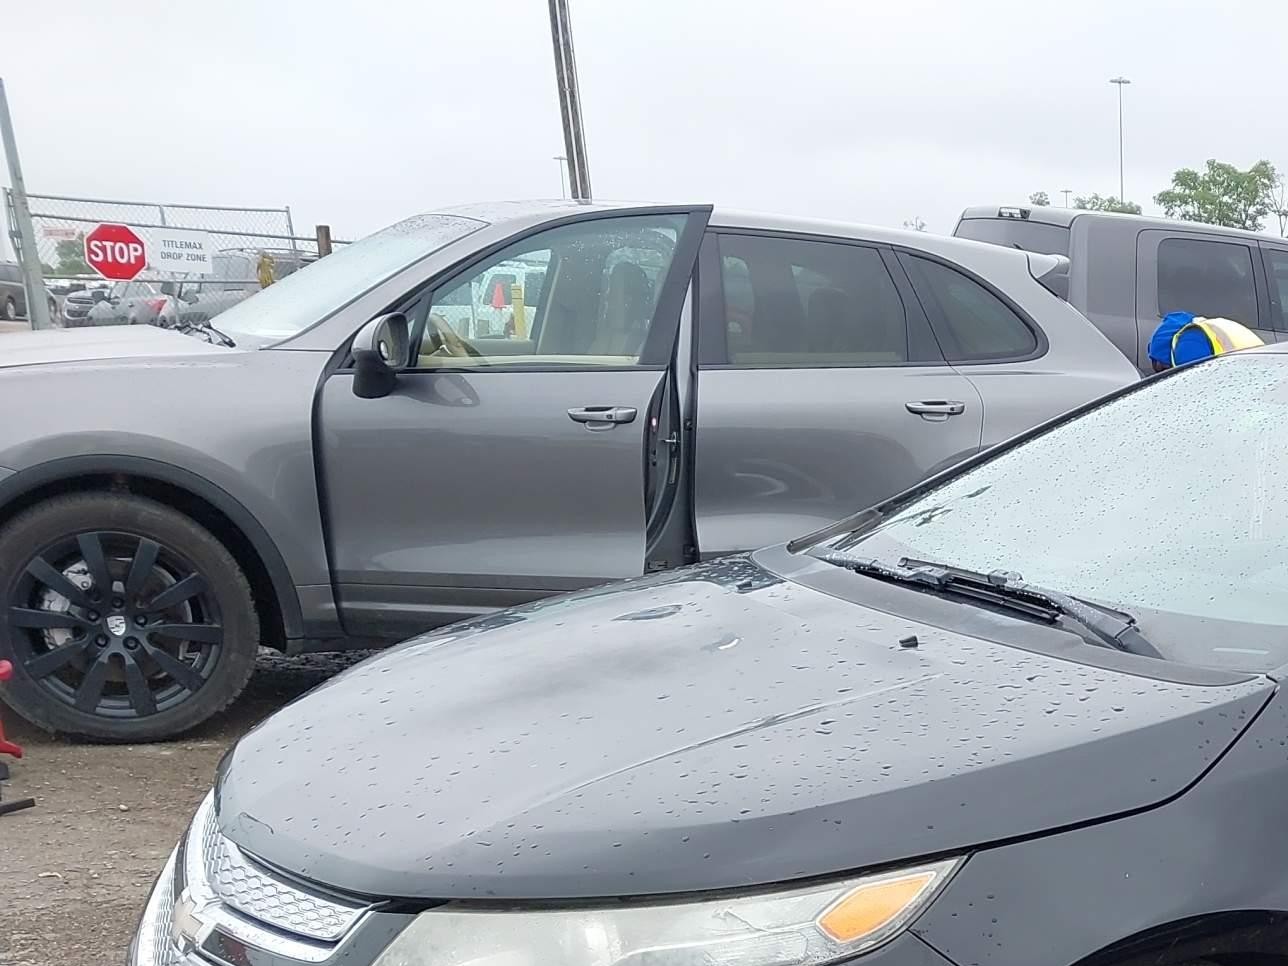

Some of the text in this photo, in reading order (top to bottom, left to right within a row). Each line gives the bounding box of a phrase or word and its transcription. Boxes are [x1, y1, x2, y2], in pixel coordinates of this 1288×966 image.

[162, 240, 204, 250] TITLEMAX
[90, 240, 142, 264] STOP
[161, 251, 208, 262] DROP ZONE
